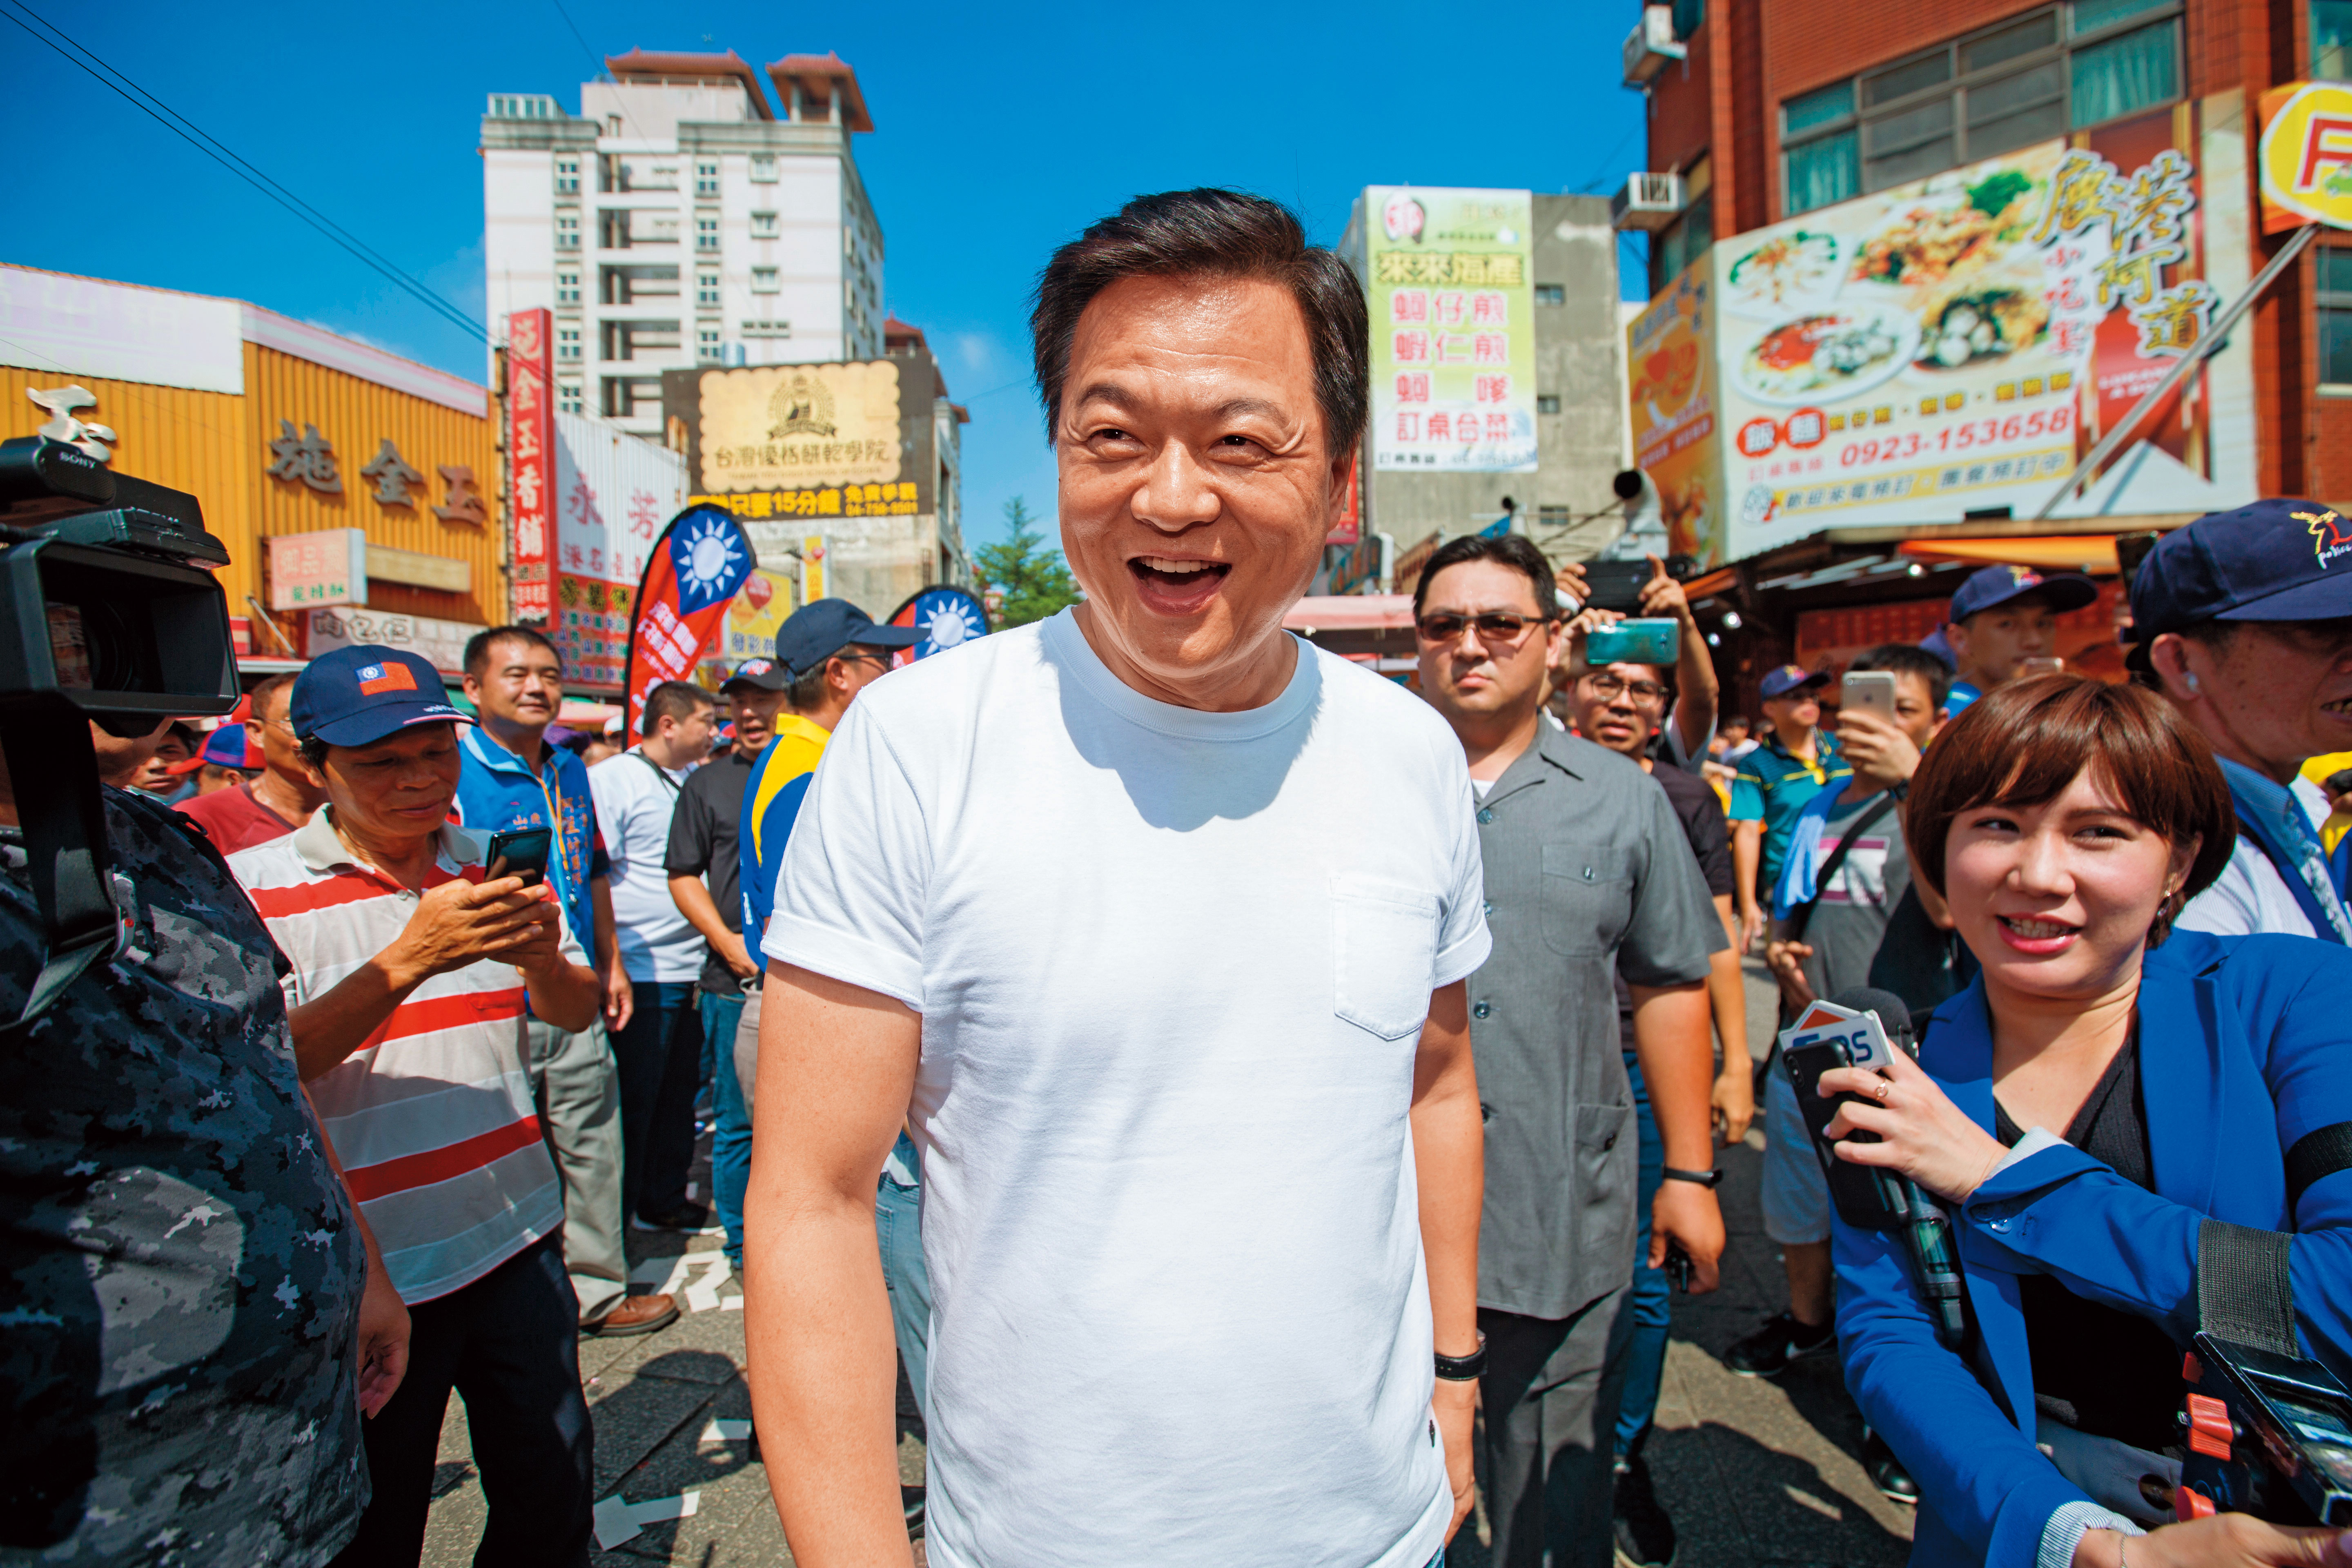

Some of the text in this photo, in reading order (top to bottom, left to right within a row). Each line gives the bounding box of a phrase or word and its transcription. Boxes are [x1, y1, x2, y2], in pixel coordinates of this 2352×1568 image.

[1393, 290, 1506, 323] 蚵仔煎
[715, 438, 891, 469] 台灣優格餅乾學院
[1840, 408, 2069, 469] 0923-153658
[60, 451, 96, 469] SONY
